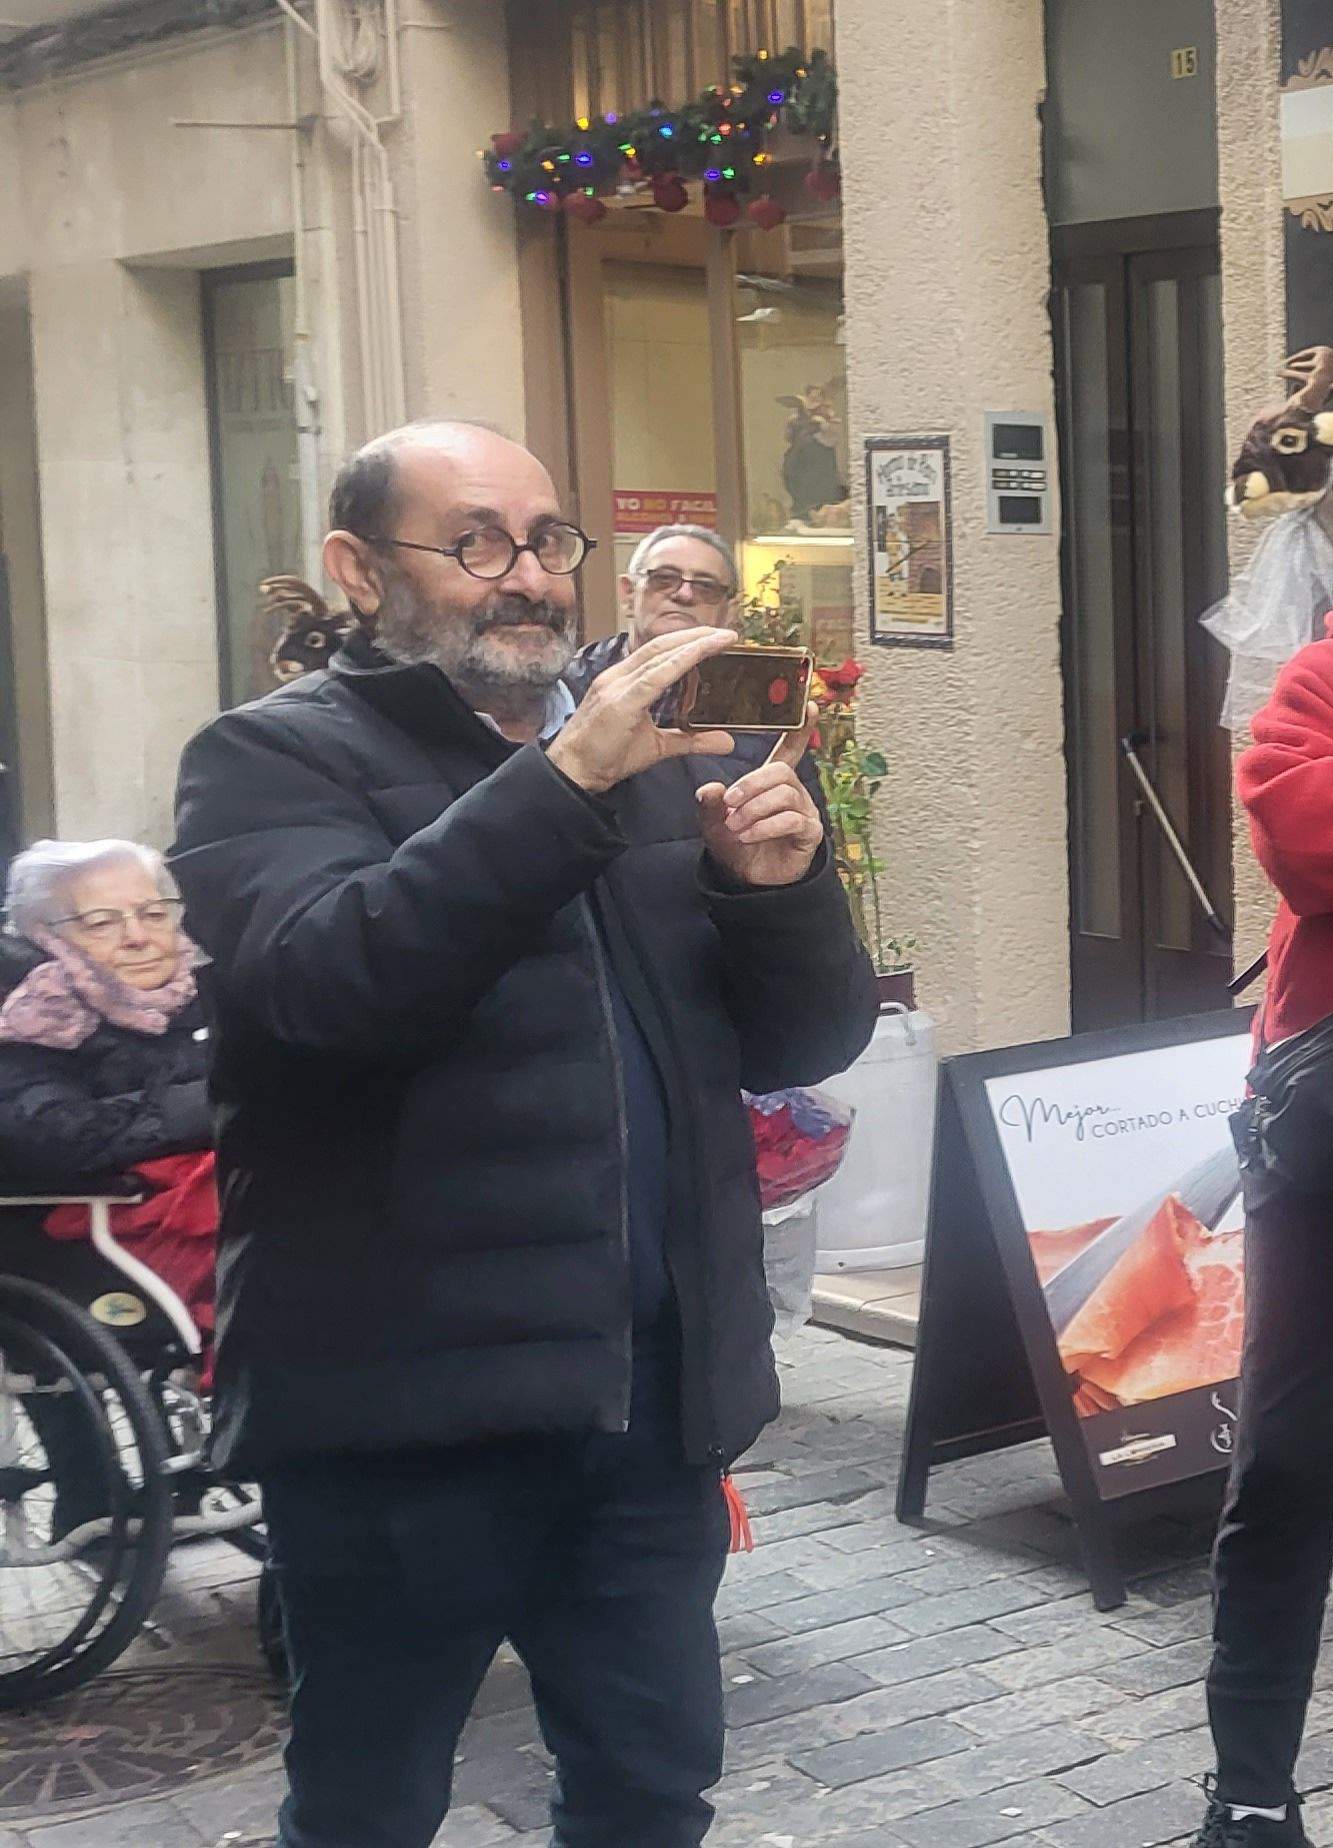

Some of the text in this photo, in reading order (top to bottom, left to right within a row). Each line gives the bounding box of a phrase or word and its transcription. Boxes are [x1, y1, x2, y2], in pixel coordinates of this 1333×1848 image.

[1177, 50, 1195, 75] 15
[1091, 1098, 1243, 1139] CORTADO A CUCH
